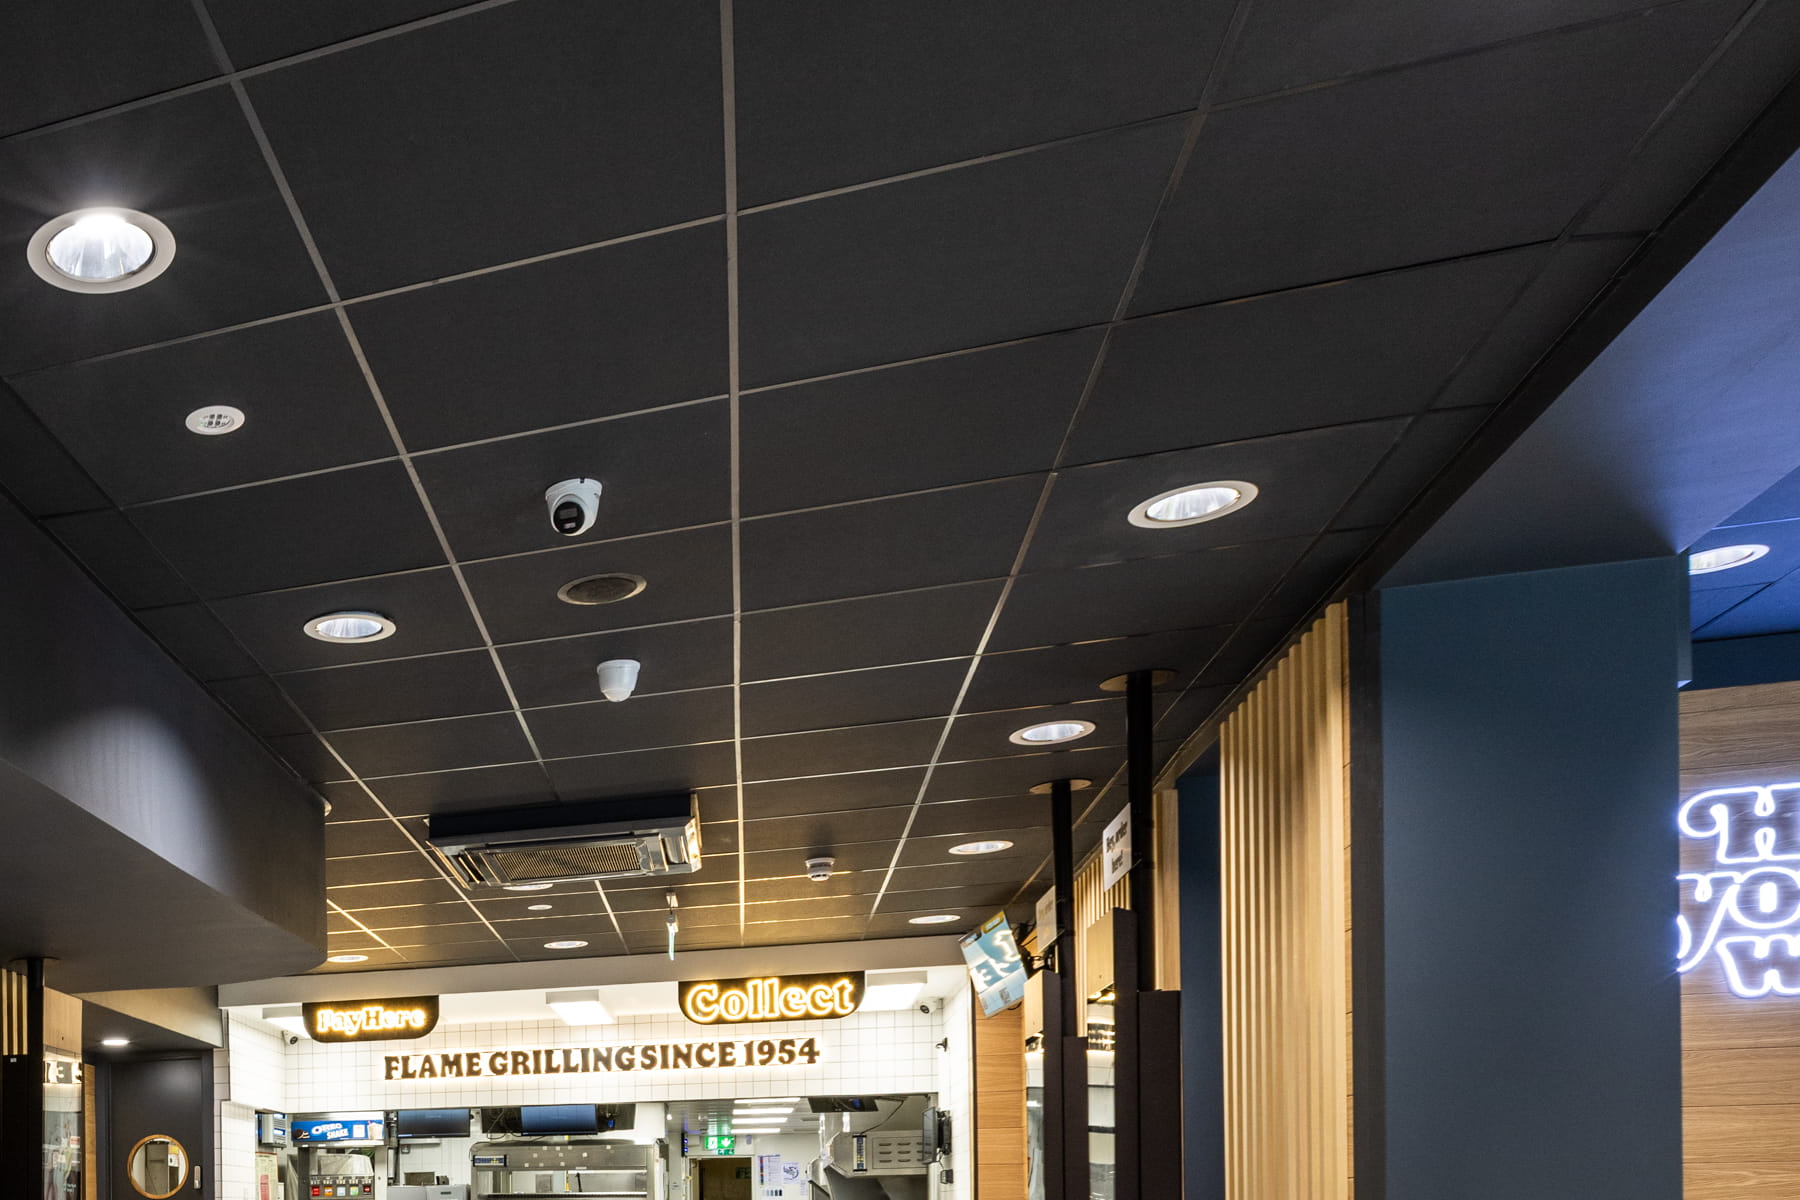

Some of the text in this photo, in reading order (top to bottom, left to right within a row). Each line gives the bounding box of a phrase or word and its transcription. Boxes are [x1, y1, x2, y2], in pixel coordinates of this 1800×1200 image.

[686, 976, 855, 1023] Collect
[384, 1037, 820, 1080] FLAME GRILLING SINCE 1954
